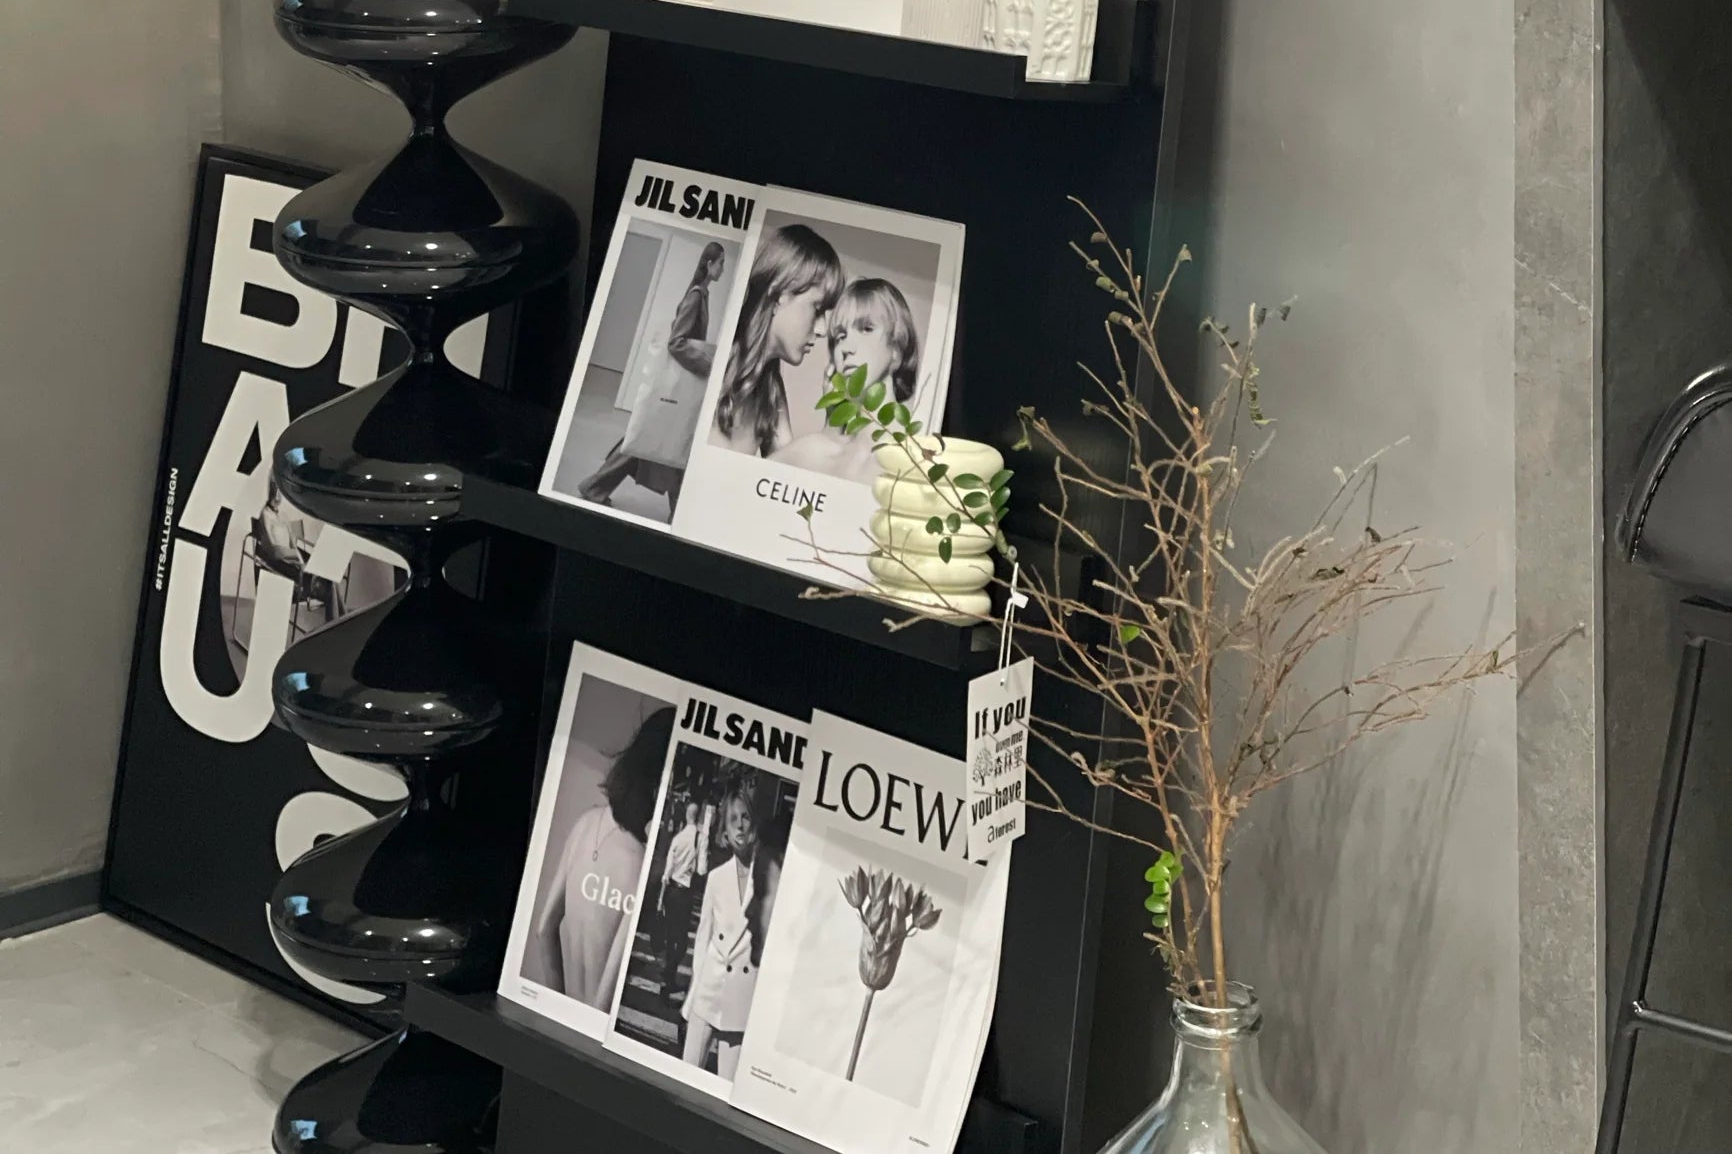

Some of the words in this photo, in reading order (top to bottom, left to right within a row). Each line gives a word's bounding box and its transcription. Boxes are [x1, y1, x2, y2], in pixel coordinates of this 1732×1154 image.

[634, 175, 676, 213] JIL
[755, 478, 827, 513] CELINE
[155, 467, 179, 591] #ITSALLDESIGN
[680, 698, 721, 741] JIL
[974, 707, 989, 740] If
[993, 696, 1026, 735] you
[813, 750, 988, 867] LOEW
[971, 797, 992, 827] you
[995, 780, 1021, 812] have
